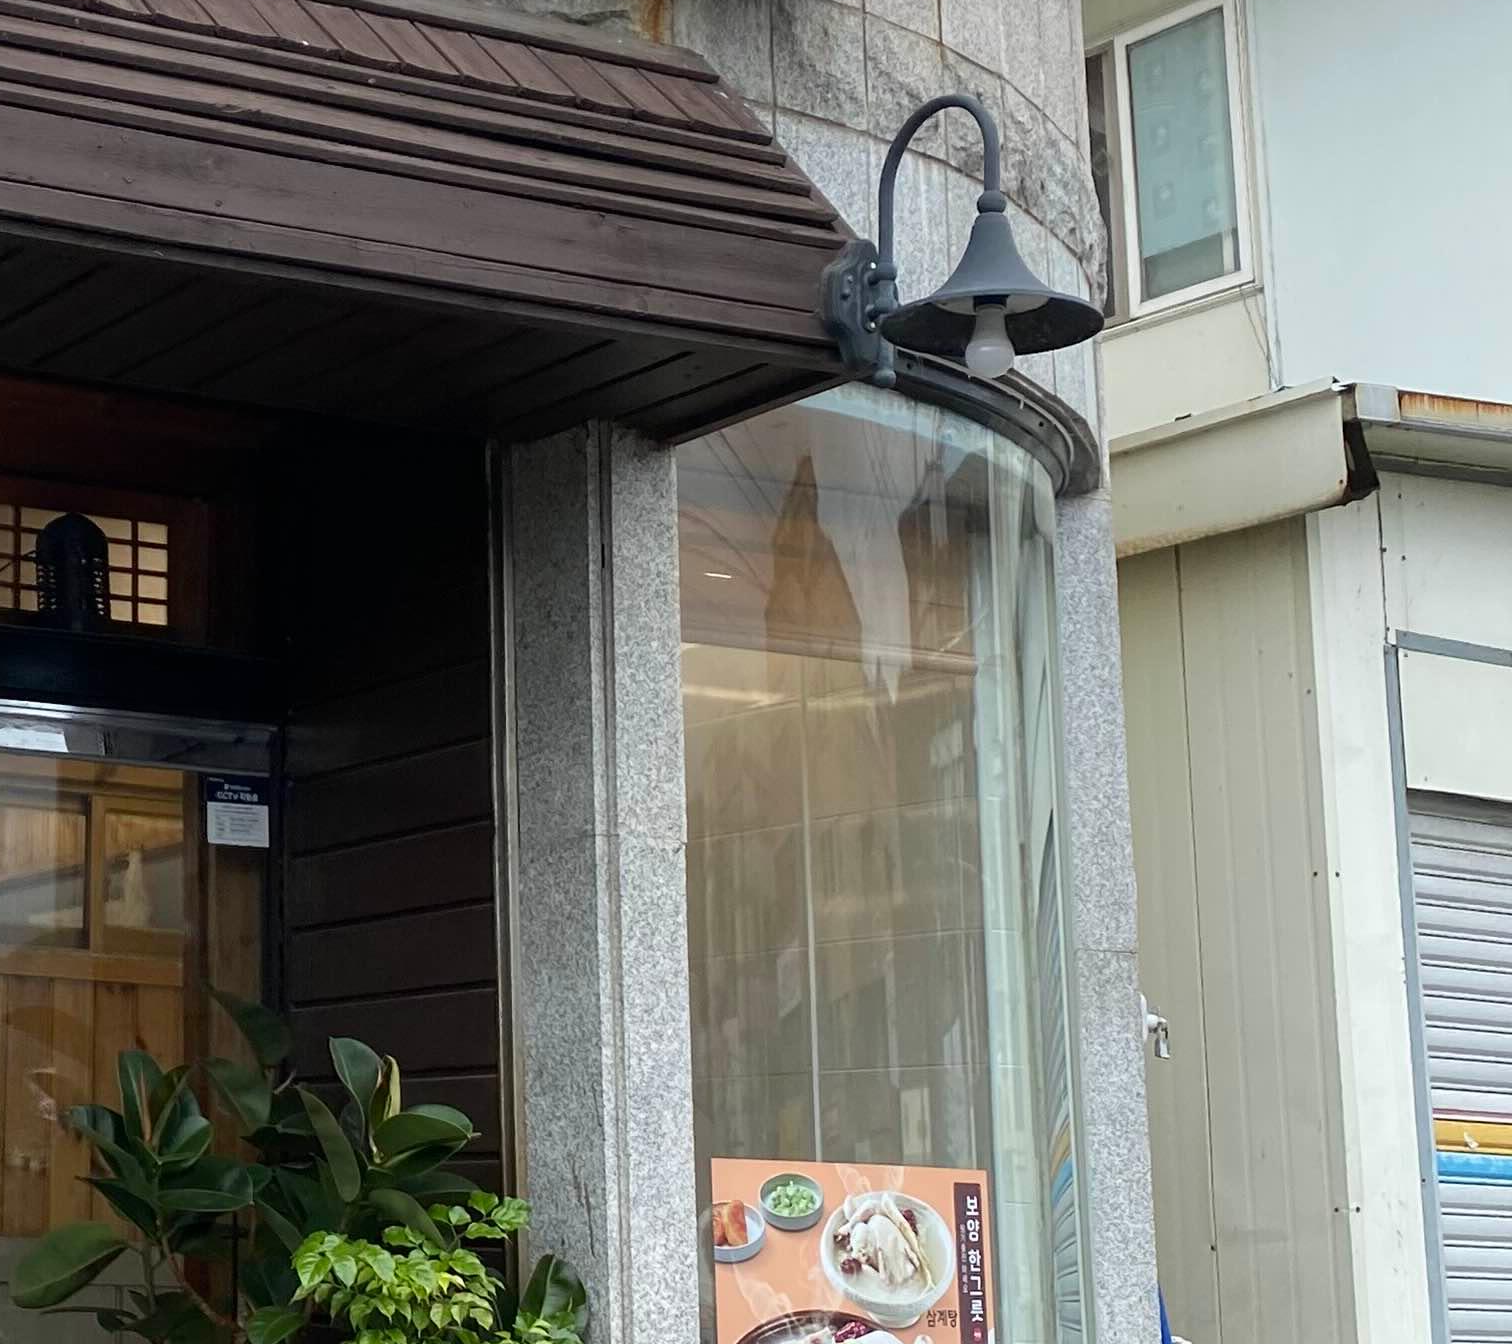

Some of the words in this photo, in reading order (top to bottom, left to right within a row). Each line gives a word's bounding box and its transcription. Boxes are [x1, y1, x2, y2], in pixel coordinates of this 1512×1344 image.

[965, 1195, 981, 1242] 보양
[967, 1248, 984, 1323] 한그릇
[926, 1309, 958, 1328] 삼계탕
